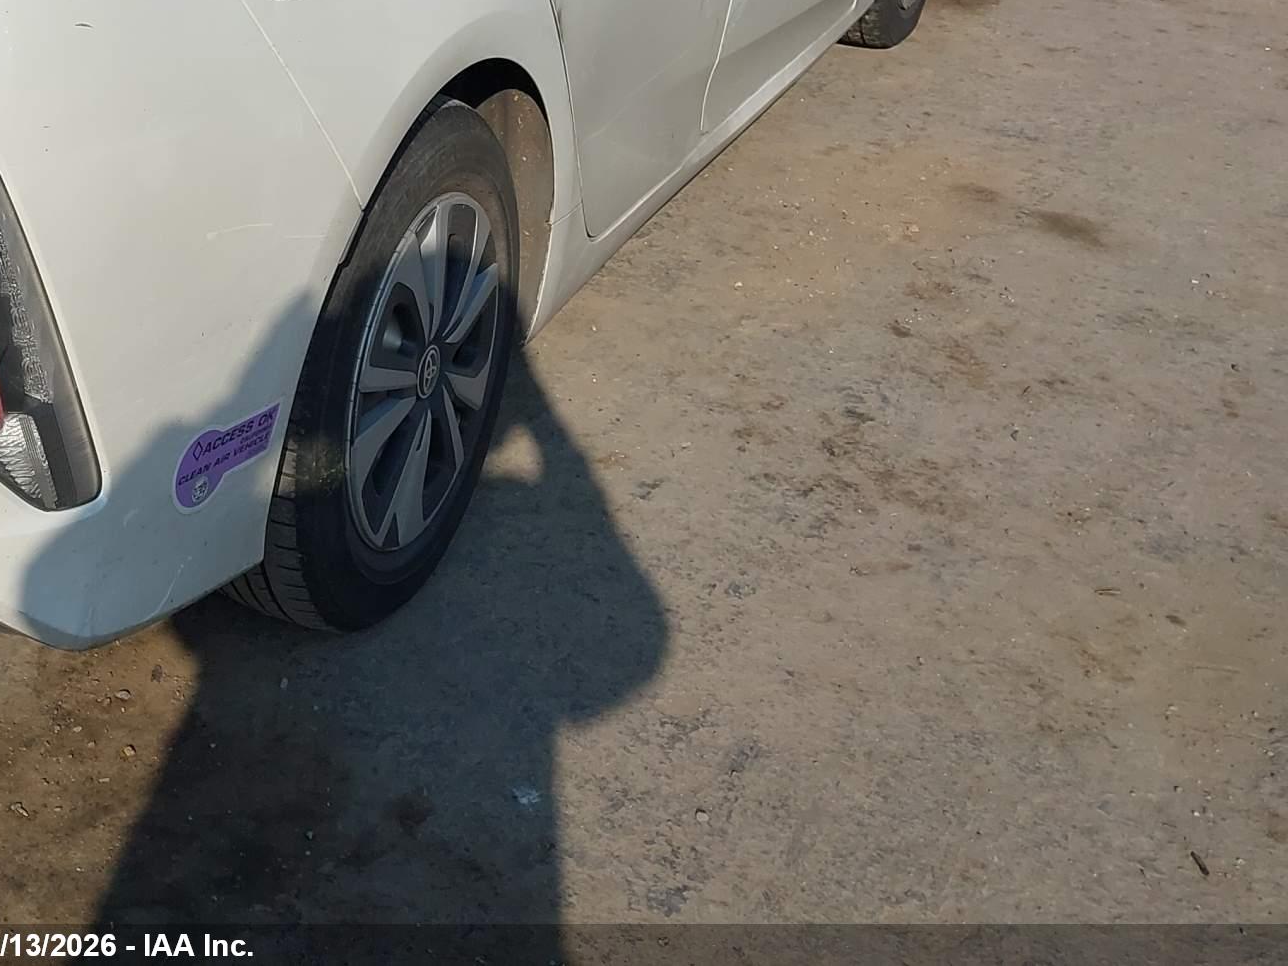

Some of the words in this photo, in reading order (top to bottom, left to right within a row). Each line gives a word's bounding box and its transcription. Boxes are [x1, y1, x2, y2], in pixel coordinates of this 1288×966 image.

[203, 421, 254, 455] ACCESS
[258, 409, 274, 427] OK
[179, 463, 211, 485] CLEAN
